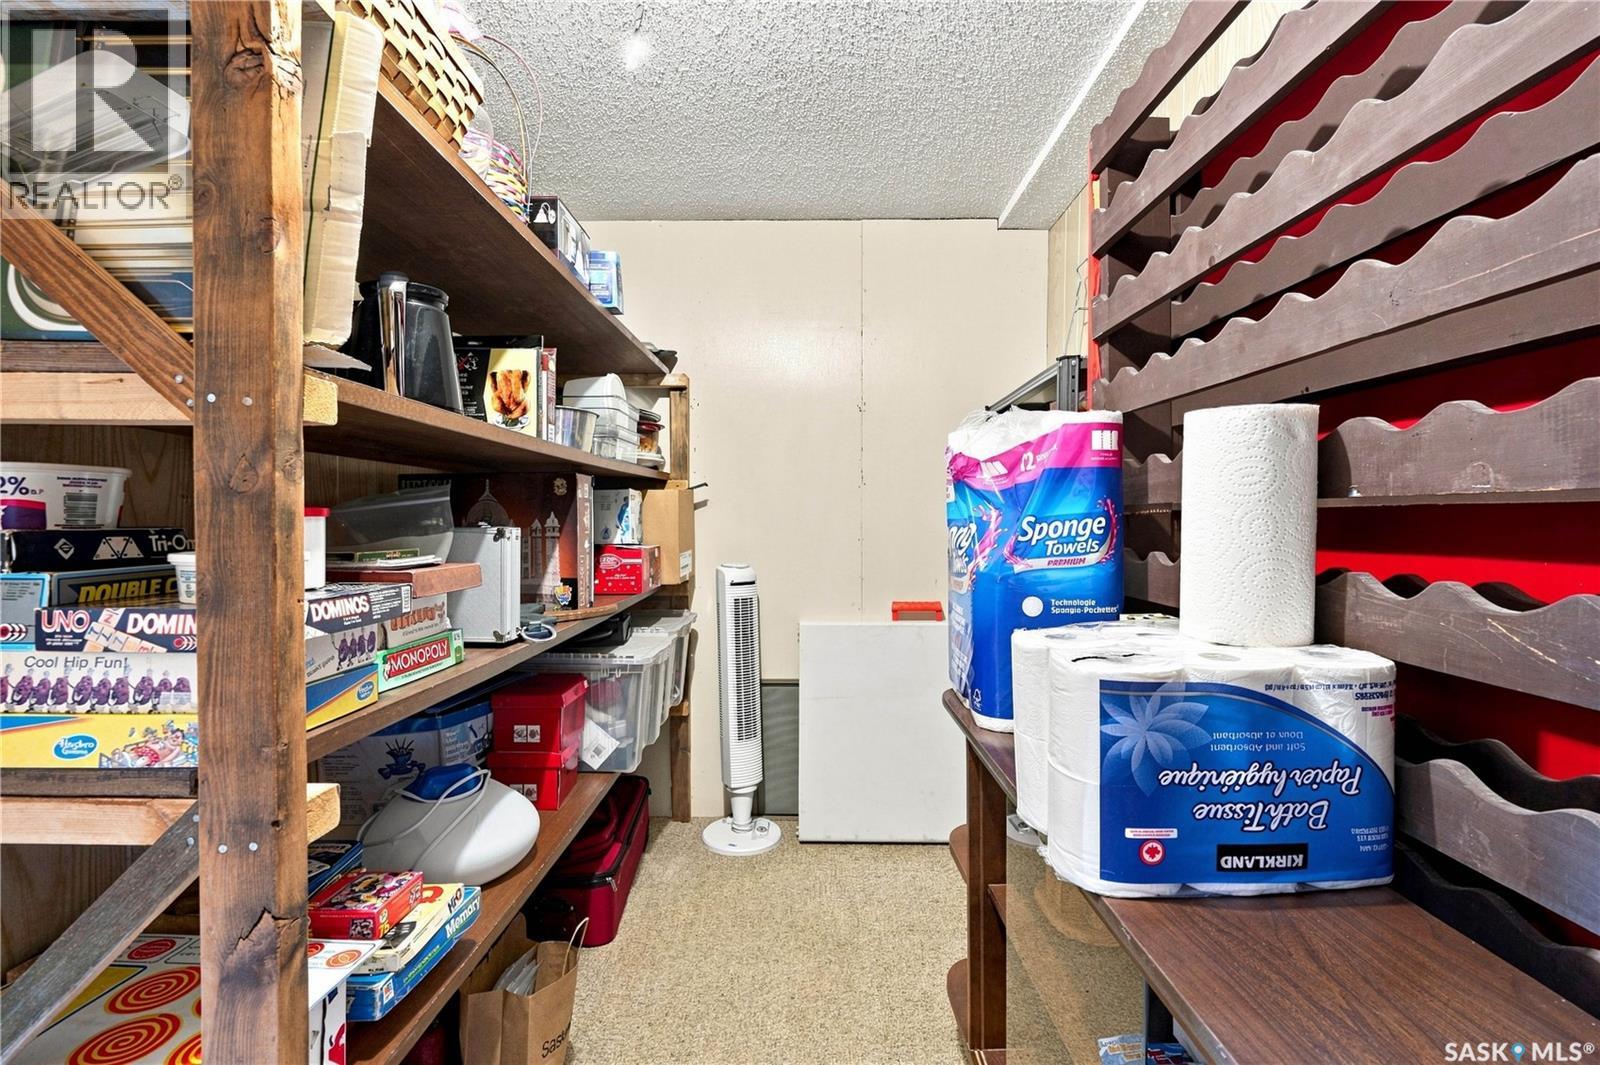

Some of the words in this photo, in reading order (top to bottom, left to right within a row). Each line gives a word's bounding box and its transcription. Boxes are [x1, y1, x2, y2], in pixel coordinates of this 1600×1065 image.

[1017, 516, 1106, 546] Sponge
[1045, 539, 1100, 556] Towels
[1047, 557, 1087, 567] PREMIUM
[79, 578, 163, 602] DOUBLE
[310, 595, 370, 623] DOMINOS
[1050, 598, 1096, 607] Technologie
[41, 609, 91, 633] UNO
[24, 655, 58, 668] Cool
[64, 656, 88, 670] Hip
[94, 656, 128, 669] Fun!
[390, 640, 448, 673] MONOPOLY
[1213, 731, 1264, 741] absorbant
[1210, 743, 1263, 753] Absorbent
[1265, 743, 1283, 752] and
[1286, 742, 1306, 752] Soft
[1158, 760, 1288, 798] hygiénique
[1289, 758, 1362, 795] Papier
[1220, 854, 1304, 868] KIRKLAND
[444, 896, 481, 939] Memory
